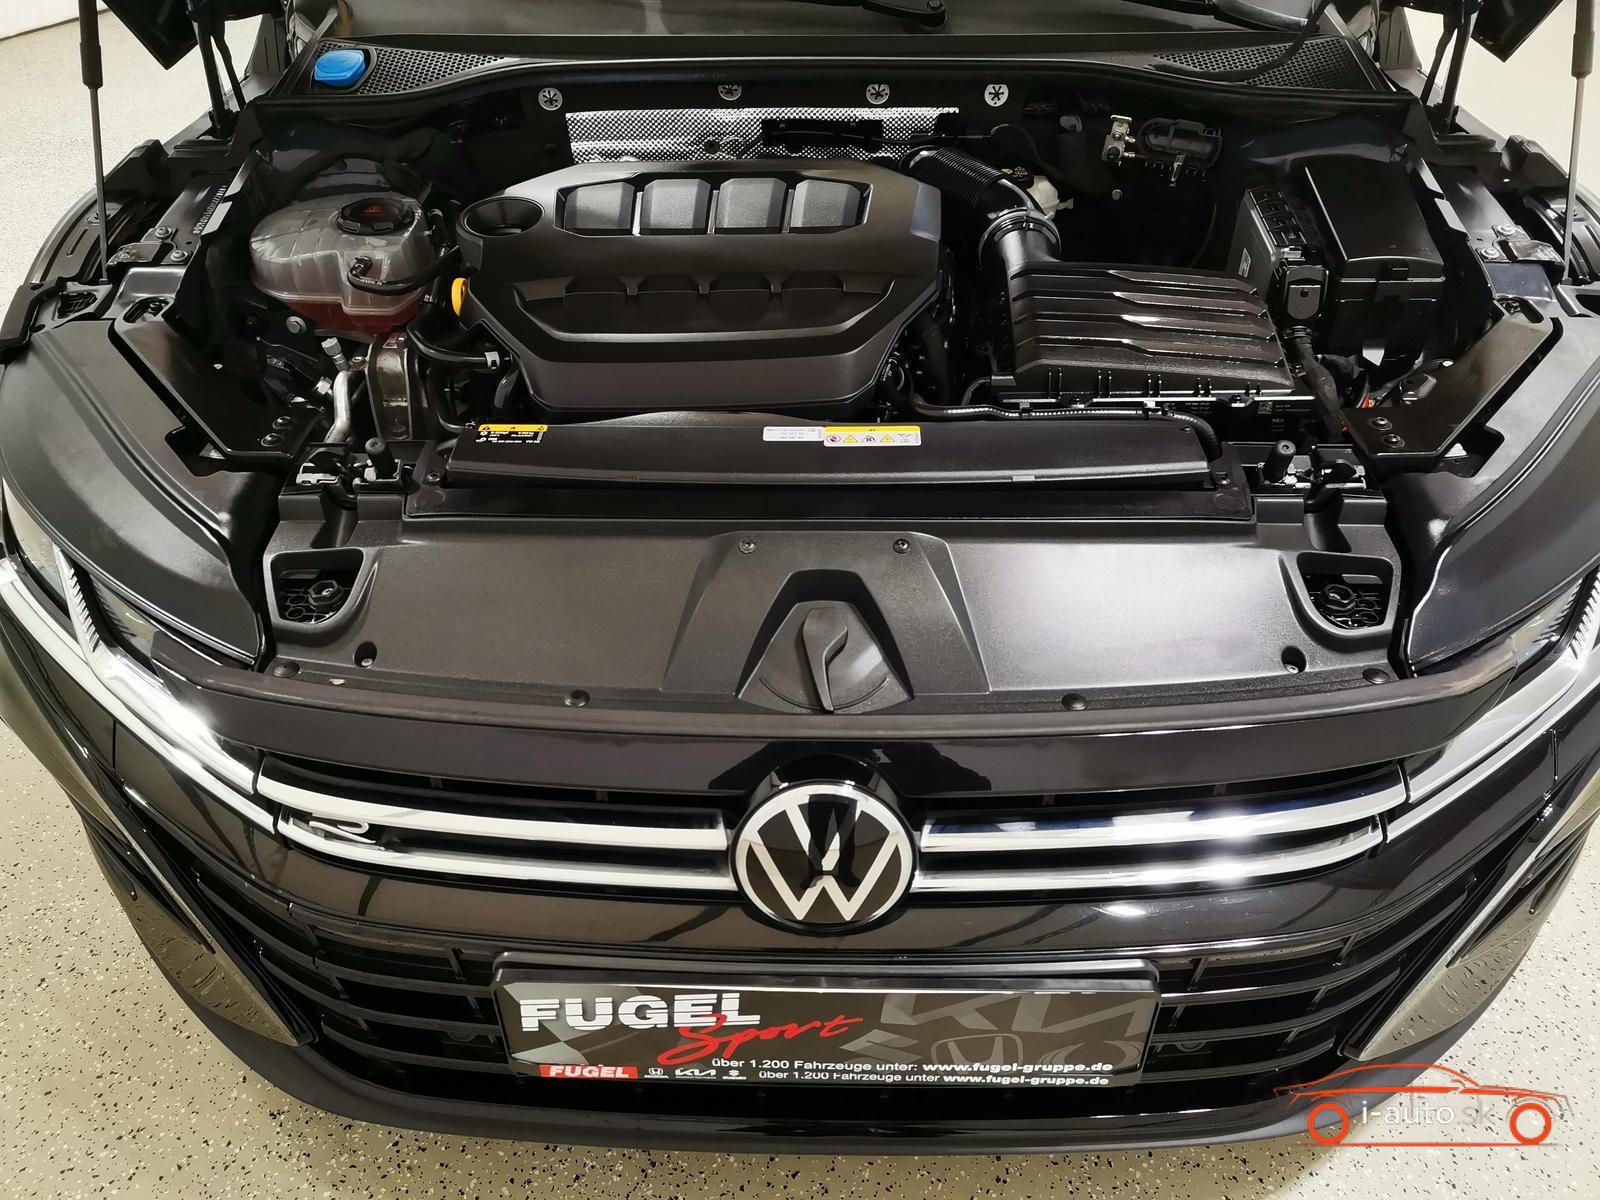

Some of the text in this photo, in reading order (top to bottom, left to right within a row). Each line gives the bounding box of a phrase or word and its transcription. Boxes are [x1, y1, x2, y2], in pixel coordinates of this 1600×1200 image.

[519, 992, 761, 1032] FUGEL
[656, 1013, 864, 1065] Sport
[549, 1065, 630, 1078] FUGEL
[712, 1058, 1114, 1074] über 1.200 Fahrzeuge unter: www.fugel-gruppe.de
[758, 1071, 1110, 1085] über 1.200 Fahrzeuge unter www.fugel-gruppe.de
